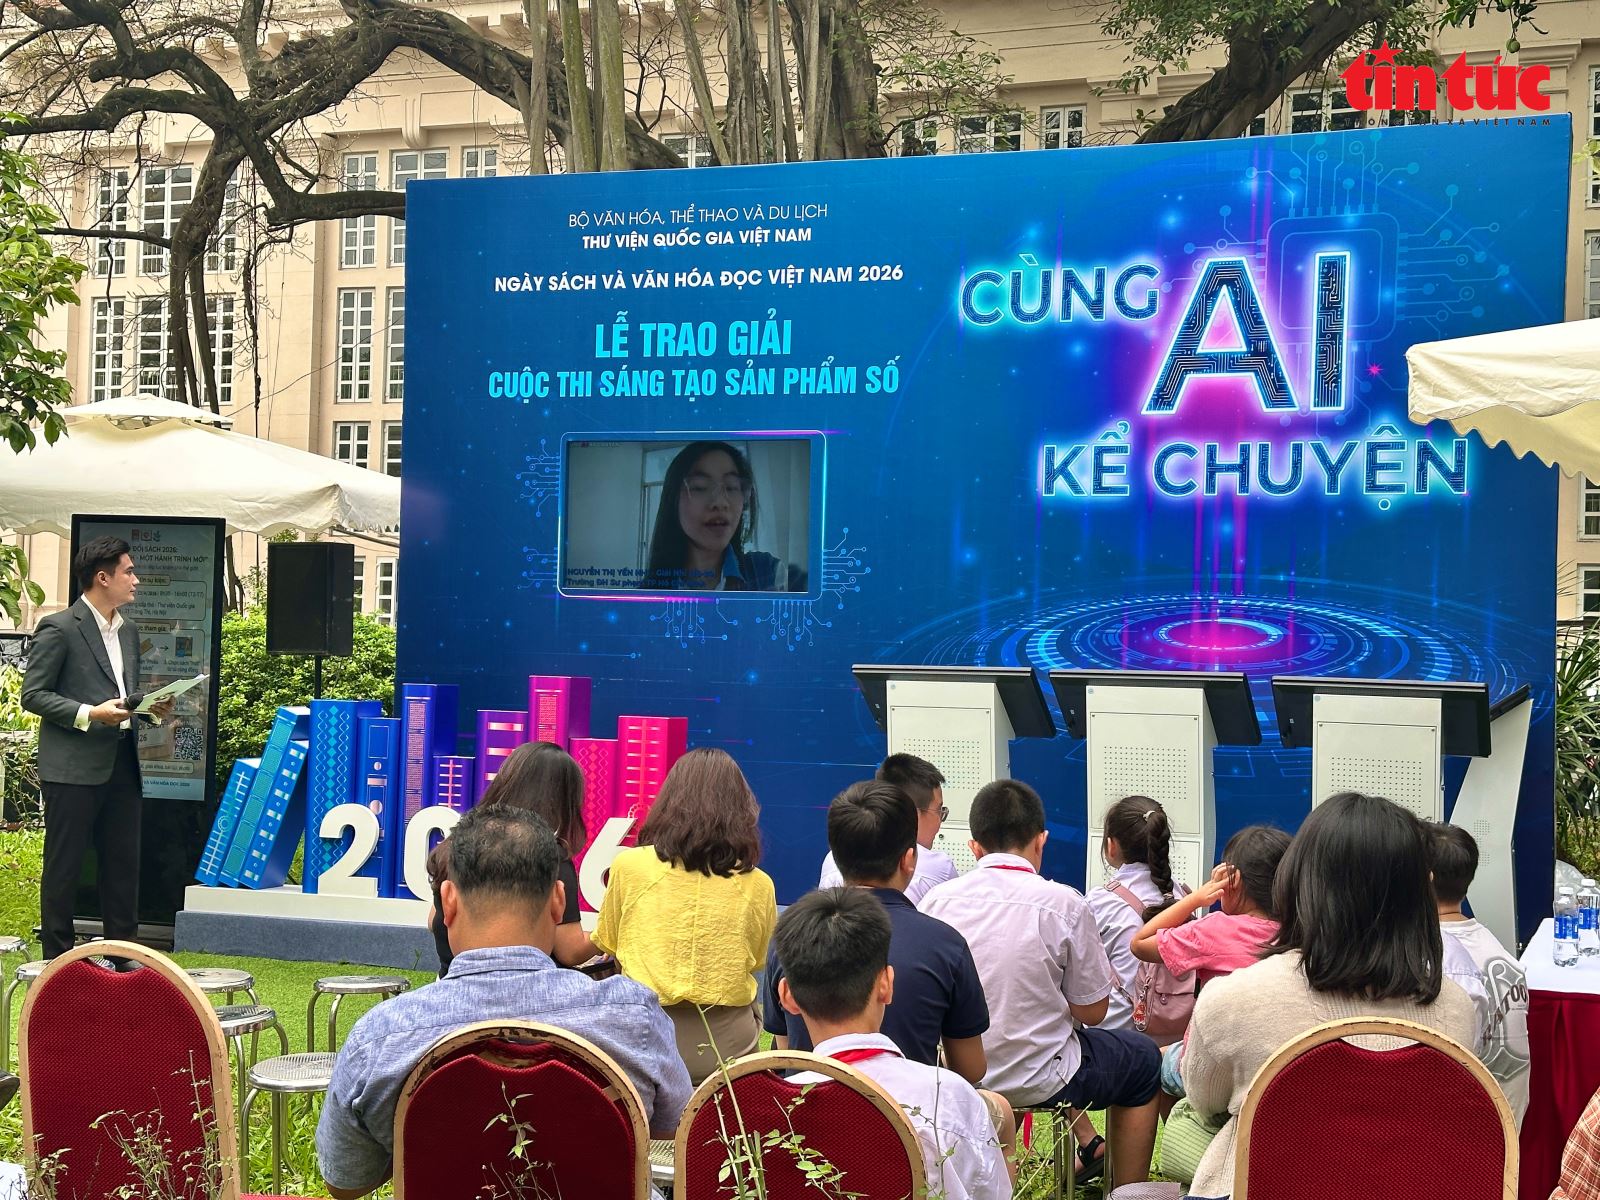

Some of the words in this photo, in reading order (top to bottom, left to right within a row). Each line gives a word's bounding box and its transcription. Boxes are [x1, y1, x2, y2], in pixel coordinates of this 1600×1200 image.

[568, 211, 590, 230] BỘ
[594, 209, 625, 227] VĂN
[629, 208, 665, 226] HÓA,
[670, 203, 696, 224] THỂ
[699, 208, 739, 223] THAO
[742, 204, 763, 221] VÀ
[768, 207, 790, 220] DU
[794, 204, 828, 222] LỊCH
[582, 233, 611, 249] THƯ
[615, 231, 648, 251] VIỆN
[652, 227, 701, 247] QUỐC
[705, 231, 735, 245] GIA
[739, 226, 771, 247] VIỆT
[775, 228, 812, 243] NAM
[494, 272, 544, 292] NGÀY
[548, 271, 597, 291] SÁCH
[602, 269, 626, 289] VÀ
[631, 269, 669, 289] VĂN
[674, 267, 714, 288] HÓA
[720, 269, 762, 290] ĐỌC
[768, 264, 805, 288] VIỆT
[809, 267, 853, 283] NAM
[858, 264, 904, 282] 2026
[595, 310, 629, 358] LỄ
[639, 321, 717, 358] TRAO
[728, 307, 792, 356] GIẢI
[960, 252, 1160, 326] CÙNG
[1141, 250, 1352, 416] AI
[488, 366, 550, 404] CUỘC
[556, 371, 593, 398] THI
[599, 364, 665, 397] SÁNG
[671, 368, 717, 402] TẠO
[724, 359, 775, 396] SẢN
[783, 355, 857, 395] PHẨM
[865, 355, 900, 394] SỐ
[1042, 420, 1131, 498] KỂ
[1152, 423, 1470, 511] CHUYỆN
